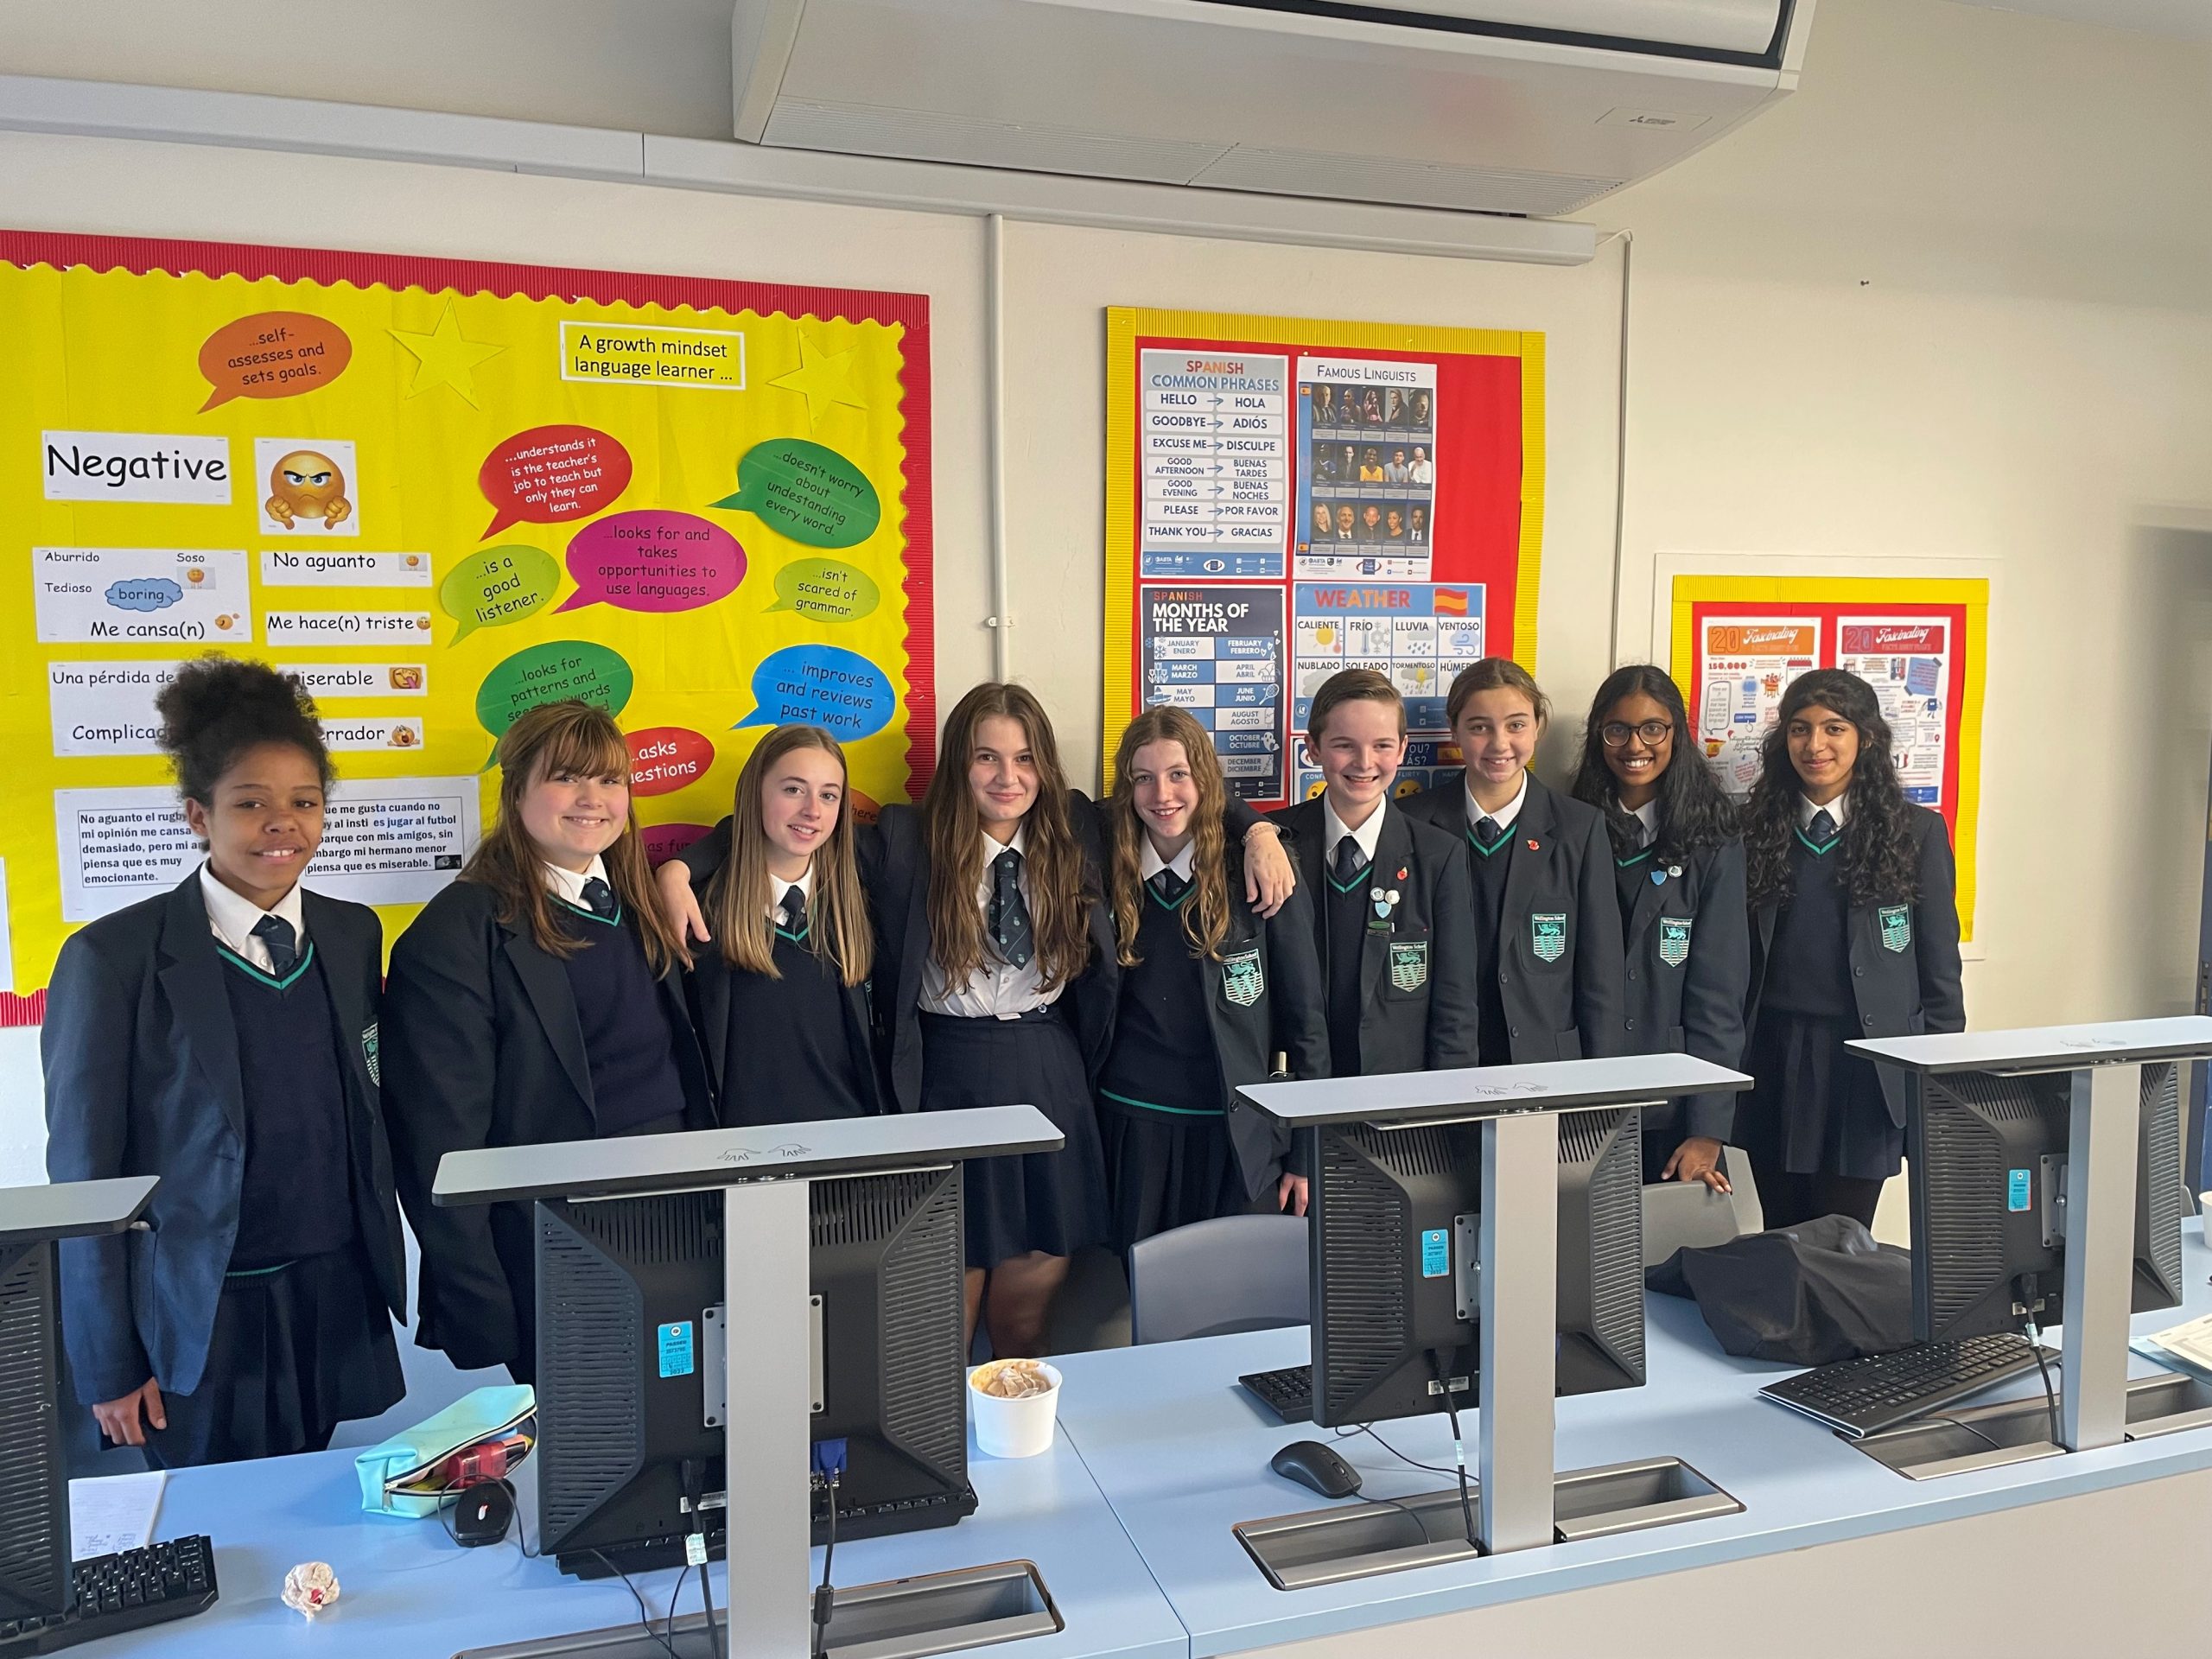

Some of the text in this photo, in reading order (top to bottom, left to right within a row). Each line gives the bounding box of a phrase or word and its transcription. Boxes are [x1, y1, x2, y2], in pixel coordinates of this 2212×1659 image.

[580, 335, 727, 358] A growth mindset
[228, 343, 325, 369] assesses and
[243, 363, 321, 385] sets goals.
[575, 357, 715, 378] language learner
[1187, 360, 1243, 374] SPANISH
[1152, 375, 1279, 391] COMMON PHRASES
[1160, 394, 1197, 404] HELLO
[1236, 397, 1265, 408] HOLA
[1153, 416, 1205, 427] GOODBYE
[1233, 416, 1267, 429] ADIÓS
[588, 438, 595, 447] it
[1154, 439, 1206, 448] EXCUSE ME
[1227, 442, 1275, 451] DISCULPE
[48, 445, 226, 487] Negative
[512, 454, 597, 476] is the teacher's
[514, 480, 531, 493] job
[550, 472, 581, 484] teach
[583, 467, 601, 478] but
[830, 474, 863, 498] worry
[1234, 481, 1268, 490] BUENAS
[526, 484, 598, 503] only they can
[796, 478, 830, 498] about
[1233, 492, 1268, 500] NOCHES
[550, 501, 581, 512] learn.
[768, 482, 846, 525] undestanding
[1164, 505, 1198, 515] PLEASE
[766, 499, 834, 537] every word.
[1225, 506, 1278, 516] POR FAVOR
[658, 526, 680, 539] for
[685, 528, 709, 540] and
[1149, 527, 1207, 537] THANK YOU
[1231, 528, 1272, 537] GRACIAS
[45, 552, 99, 563] Aburrido
[177, 553, 205, 563] Soso
[638, 545, 677, 557] takes
[274, 553, 376, 571] No aguanto
[503, 558, 512, 568] a
[599, 564, 716, 579] opportunities to
[45, 583, 92, 594] Tedioso
[484, 573, 520, 601] good
[607, 582, 709, 599] use languages.
[798, 582, 857, 601] scared of
[118, 588, 164, 603] boring
[1154, 591, 1203, 601] SPANISH
[1314, 588, 1410, 607] WEATHER
[476, 593, 543, 622] listener.
[796, 600, 853, 616] grammar.
[1153, 604, 1249, 618] MONTHS OF
[91, 621, 205, 639] Me cansa(n)
[269, 616, 414, 632] Me hace(n) triste
[1153, 618, 1229, 632] THE YEAR
[1351, 620, 1373, 631] FRÍO
[1395, 622, 1428, 631] LLUVIA
[1712, 626, 1798, 653] 20 Fascinating
[1846, 626, 1929, 652] 20 Fascinating
[561, 658, 582, 671] for
[53, 671, 174, 687] Una pérdida de
[802, 661, 873, 688] improves
[512, 669, 596, 705] patterns and
[777, 682, 873, 709] and reviews
[781, 704, 861, 728] past work
[359, 804, 386, 815] gusta
[389, 803, 425, 811] cuando
[81, 814, 142, 824] No aguanto
[98, 828, 137, 840] opinión
[84, 860, 119, 870] piensa
[123, 859, 142, 868] que
[161, 857, 181, 867] muy
[308, 863, 340, 874] piensa
[344, 863, 362, 872] que
[379, 859, 431, 868] miserable.
[85, 873, 158, 883] emocionante.
